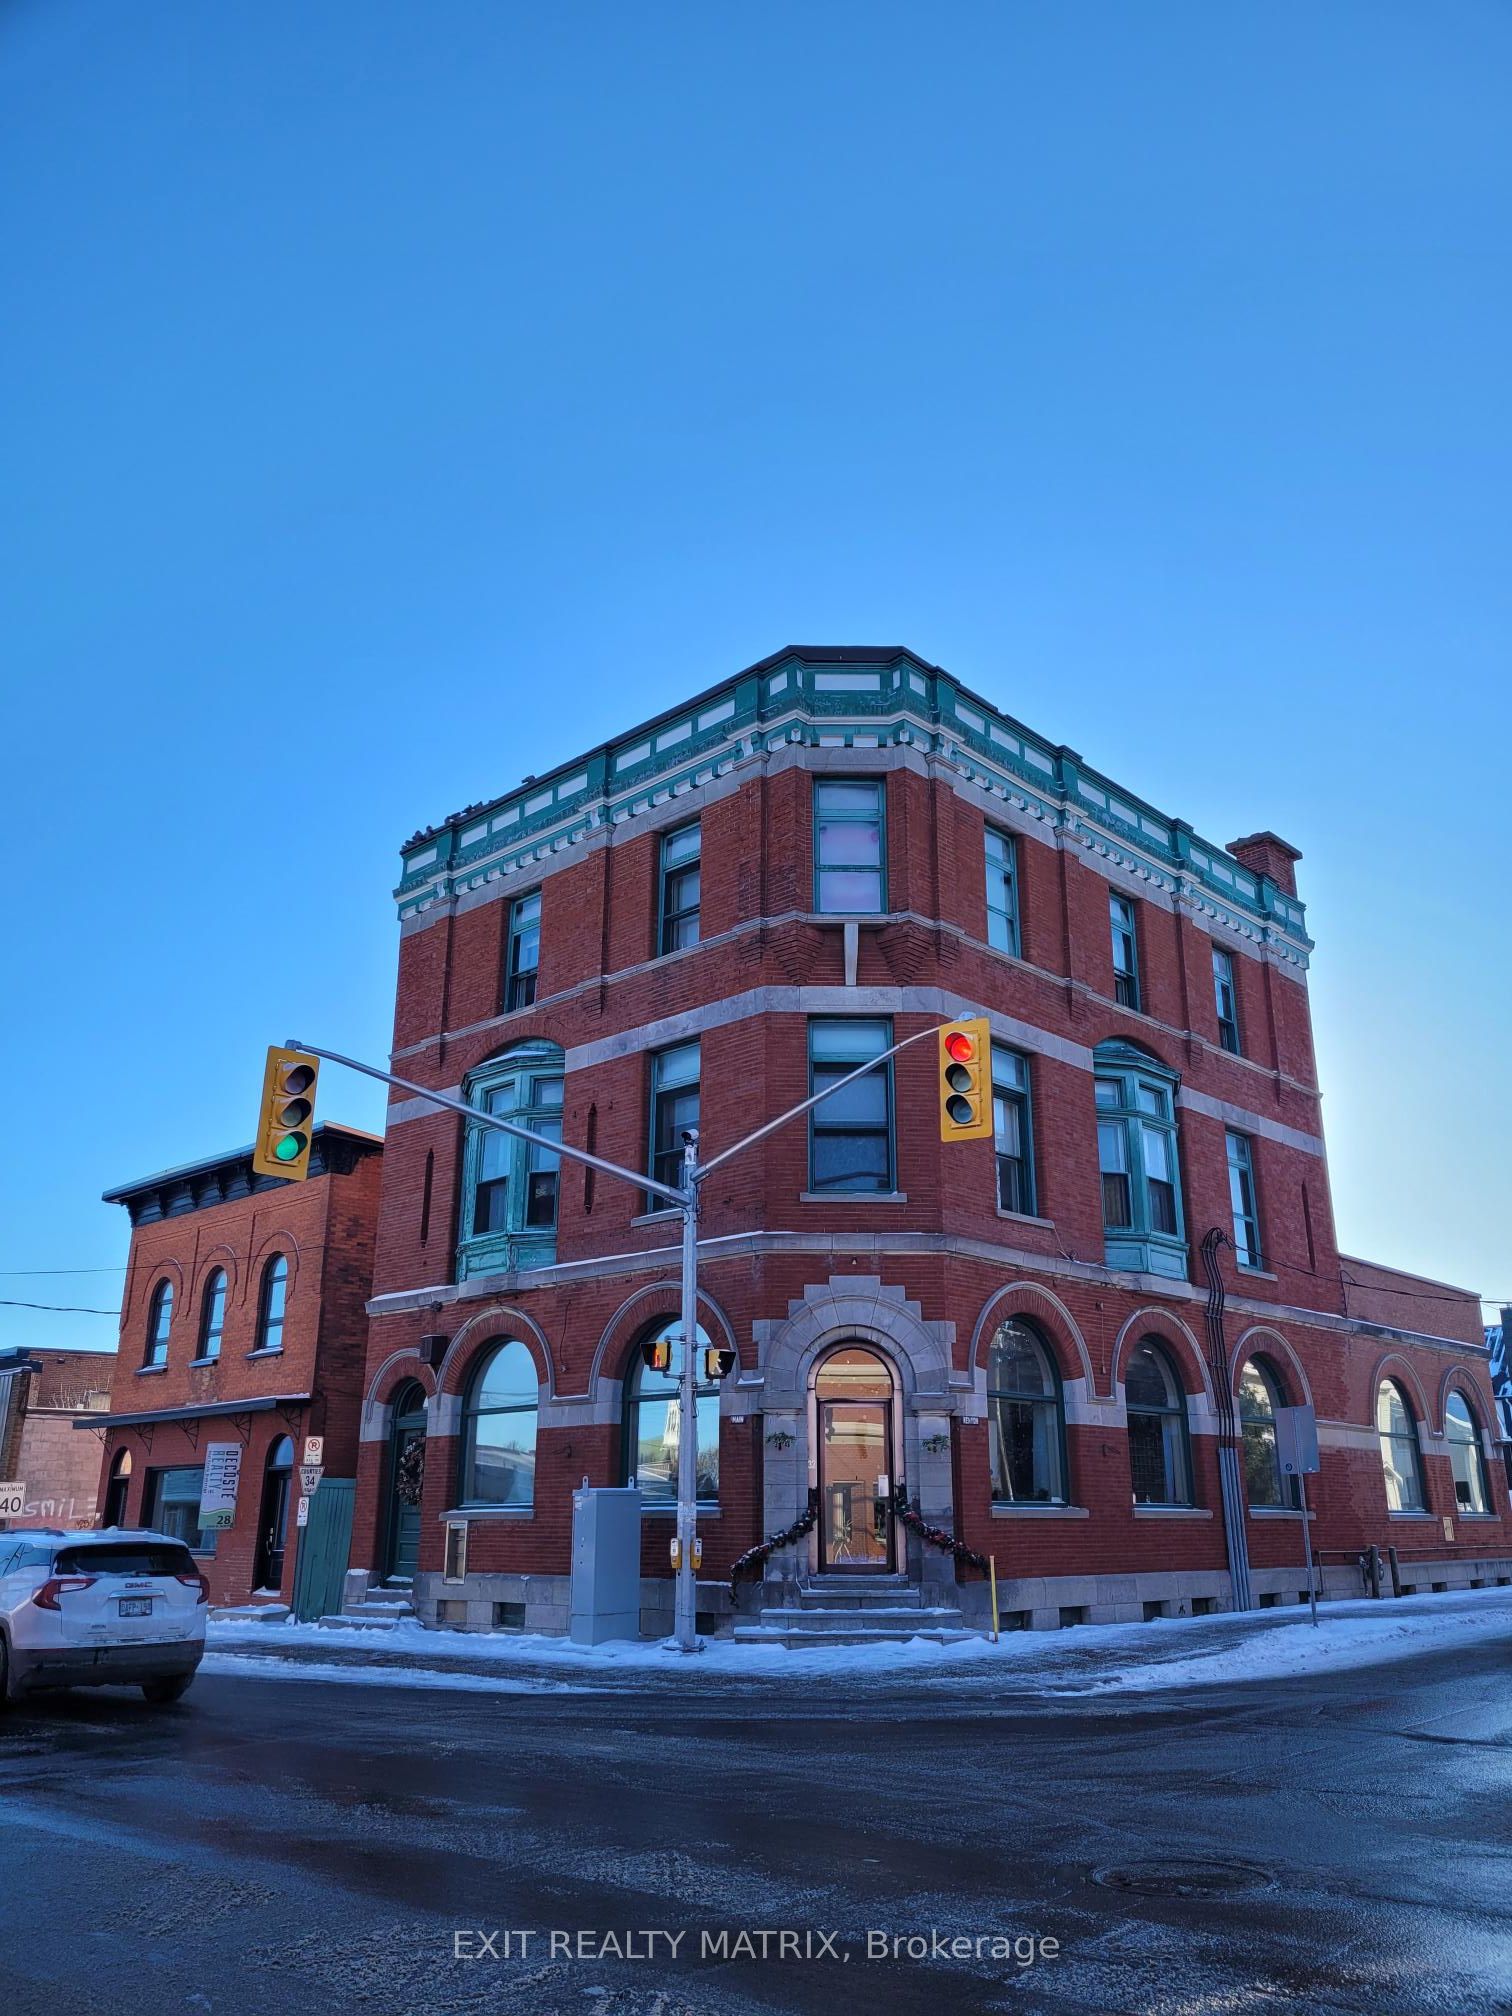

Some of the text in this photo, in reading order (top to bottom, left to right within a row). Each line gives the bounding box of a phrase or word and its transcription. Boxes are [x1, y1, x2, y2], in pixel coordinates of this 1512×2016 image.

[208, 1450, 225, 1489] REALTY
[221, 1450, 239, 1498] DECOSTE
[305, 1475, 315, 1486] 34
[0, 1496, 22, 1513] 40
[216, 1515, 231, 1525] 28
